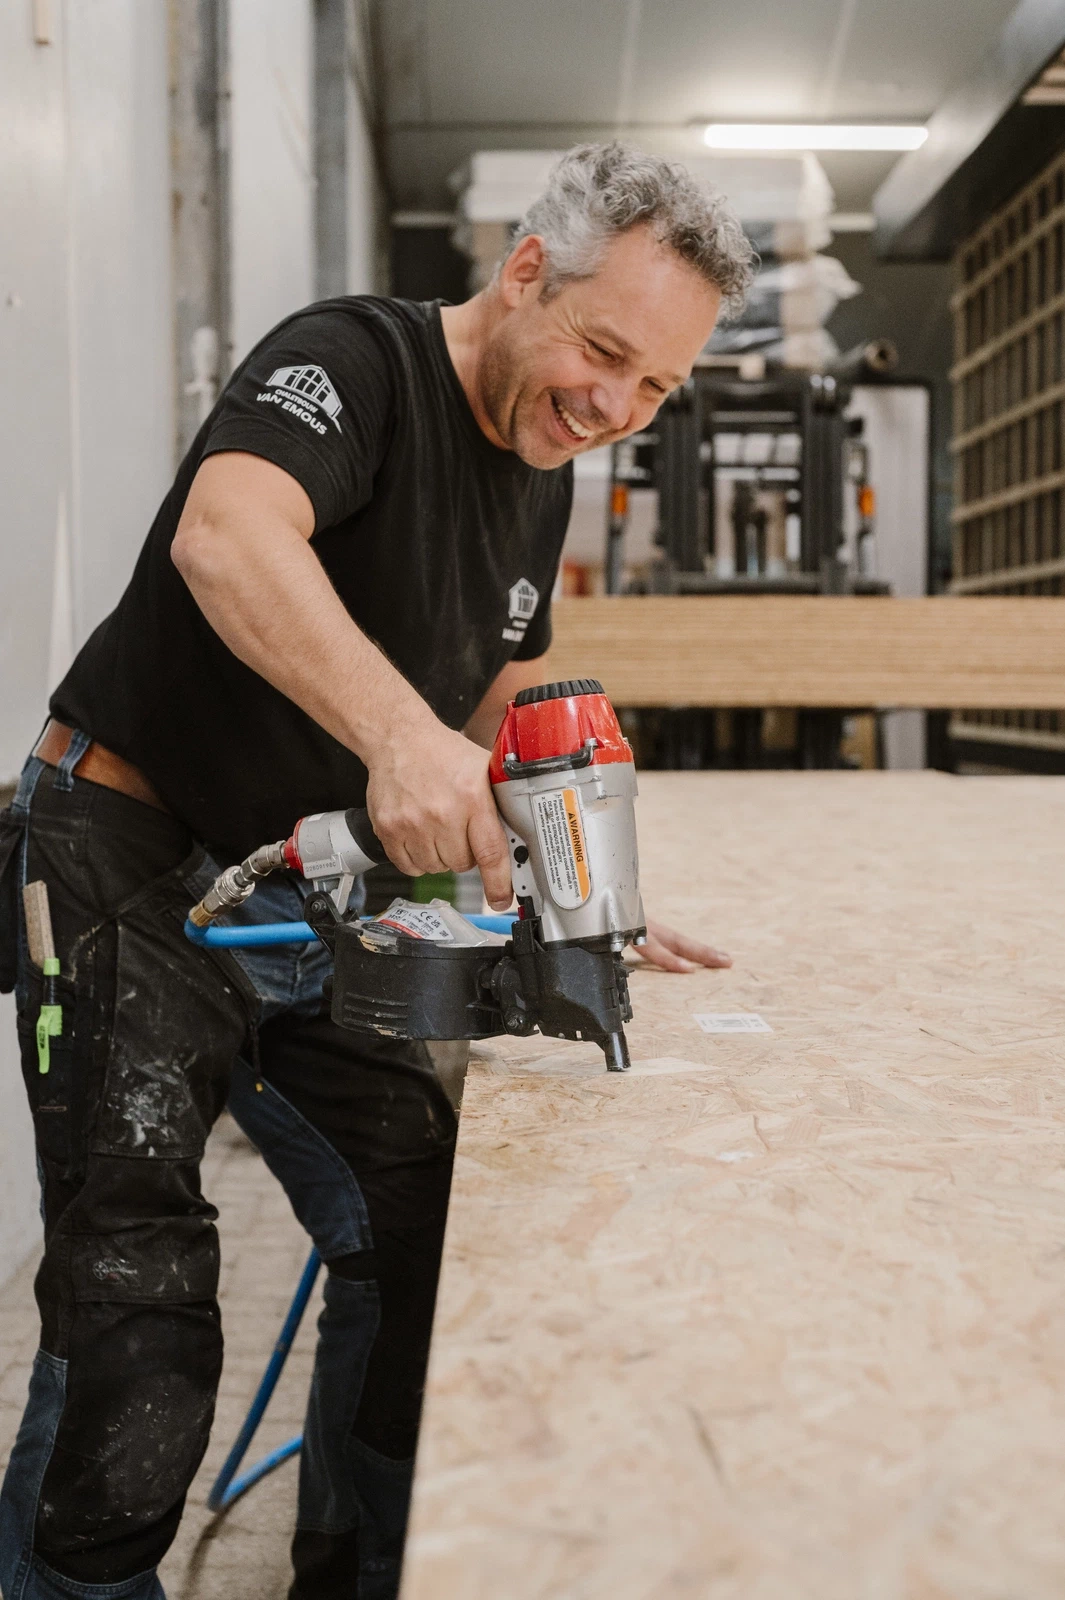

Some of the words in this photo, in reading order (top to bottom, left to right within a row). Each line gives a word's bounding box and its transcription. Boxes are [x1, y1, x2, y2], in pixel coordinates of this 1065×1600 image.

[256, 393, 282, 404] VAN
[282, 401, 328, 434] EMOUS
[274, 389, 318, 413] CHALETBOUW
[570, 820, 583, 862] WARNING
